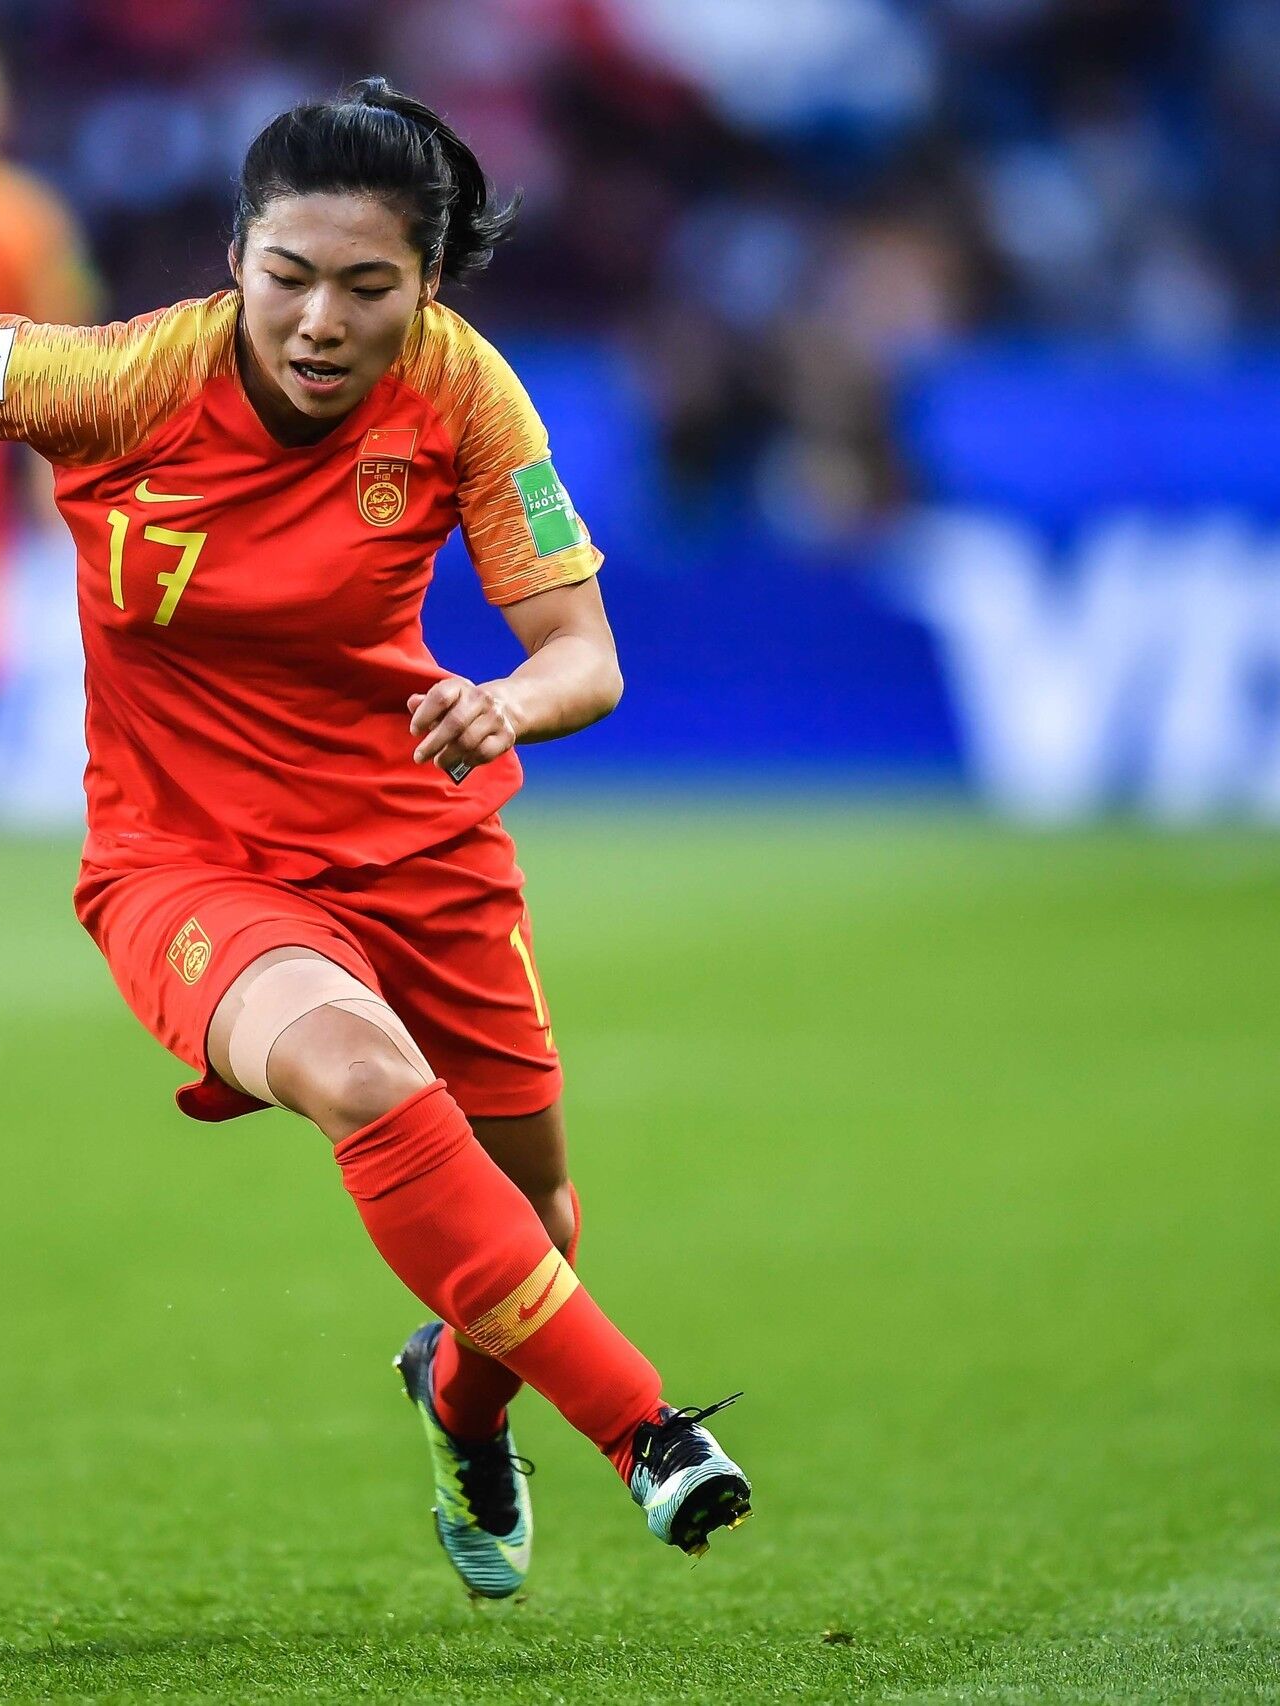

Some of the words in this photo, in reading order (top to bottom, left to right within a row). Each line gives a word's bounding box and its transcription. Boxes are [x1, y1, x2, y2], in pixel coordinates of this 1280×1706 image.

[361, 463, 405, 475] CFA
[106, 508, 208, 627] 17
[169, 921, 196, 961] CFA
